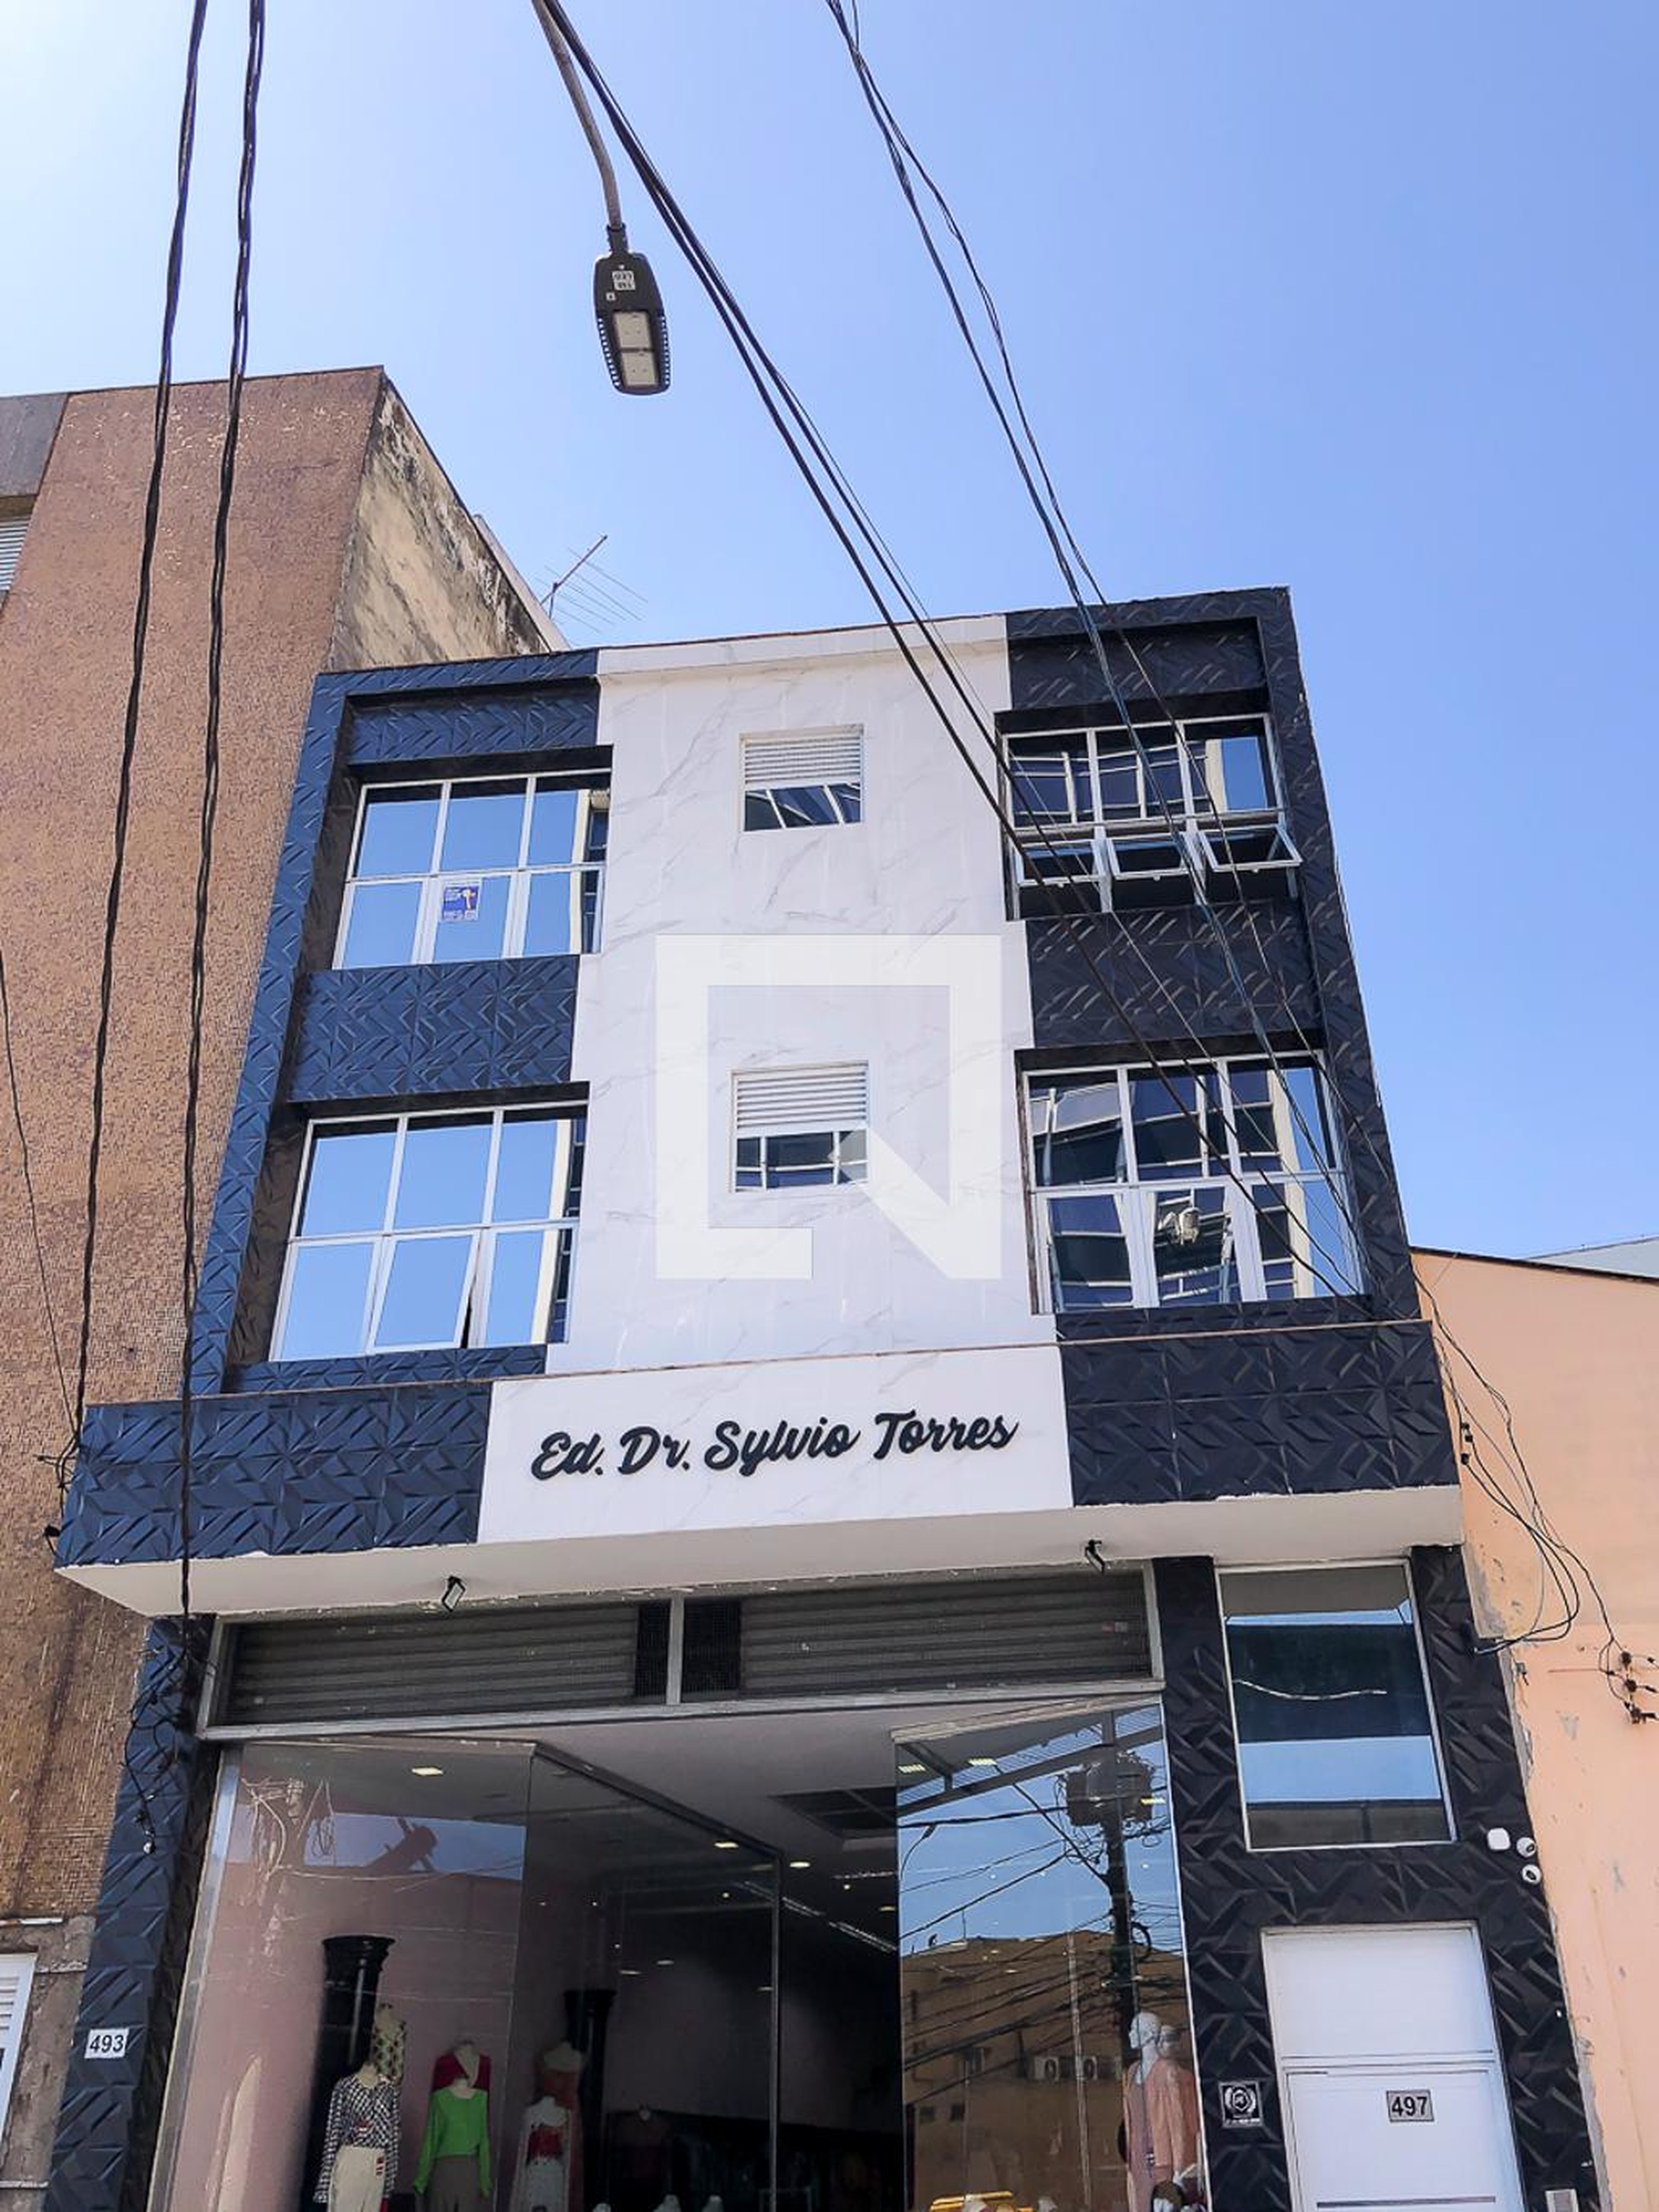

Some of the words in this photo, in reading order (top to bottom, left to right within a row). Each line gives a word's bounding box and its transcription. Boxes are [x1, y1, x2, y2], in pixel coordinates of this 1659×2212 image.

[531, 1431, 605, 1481] Ed.
[617, 1426, 691, 1476] Dr.
[703, 1416, 861, 1477] Sylvio
[873, 1409, 1020, 1461] Torres
[90, 2034, 124, 2053] 493
[1392, 2096, 1427, 2117] 497
